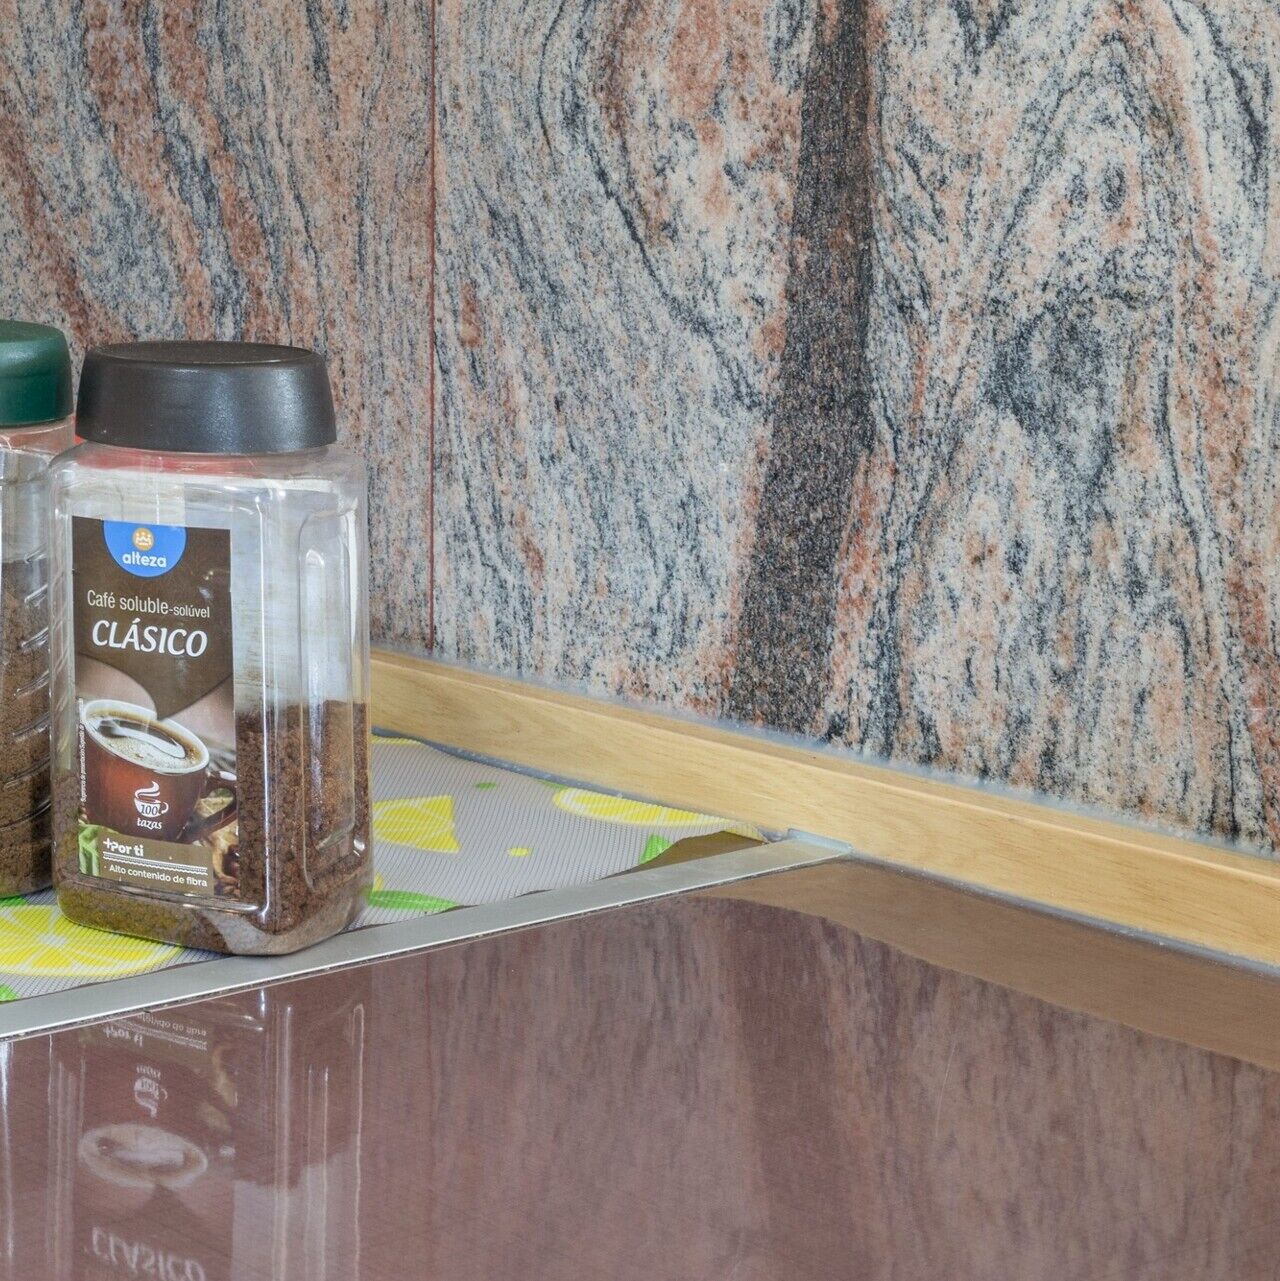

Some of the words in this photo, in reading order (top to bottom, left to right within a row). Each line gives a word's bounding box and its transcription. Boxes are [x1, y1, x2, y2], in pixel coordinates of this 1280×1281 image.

[122, 551, 167, 568] alteza
[87, 589, 116, 609] Café
[92, 617, 208, 658] CLÁSICO
[140, 804, 159, 816] 100
[137, 817, 162, 830] tazas
[133, 844, 144, 857] ti
[109, 864, 126, 875] Alto
[127, 868, 172, 882] contenido
[173, 875, 185, 884] de
[186, 876, 208, 887] fibra
